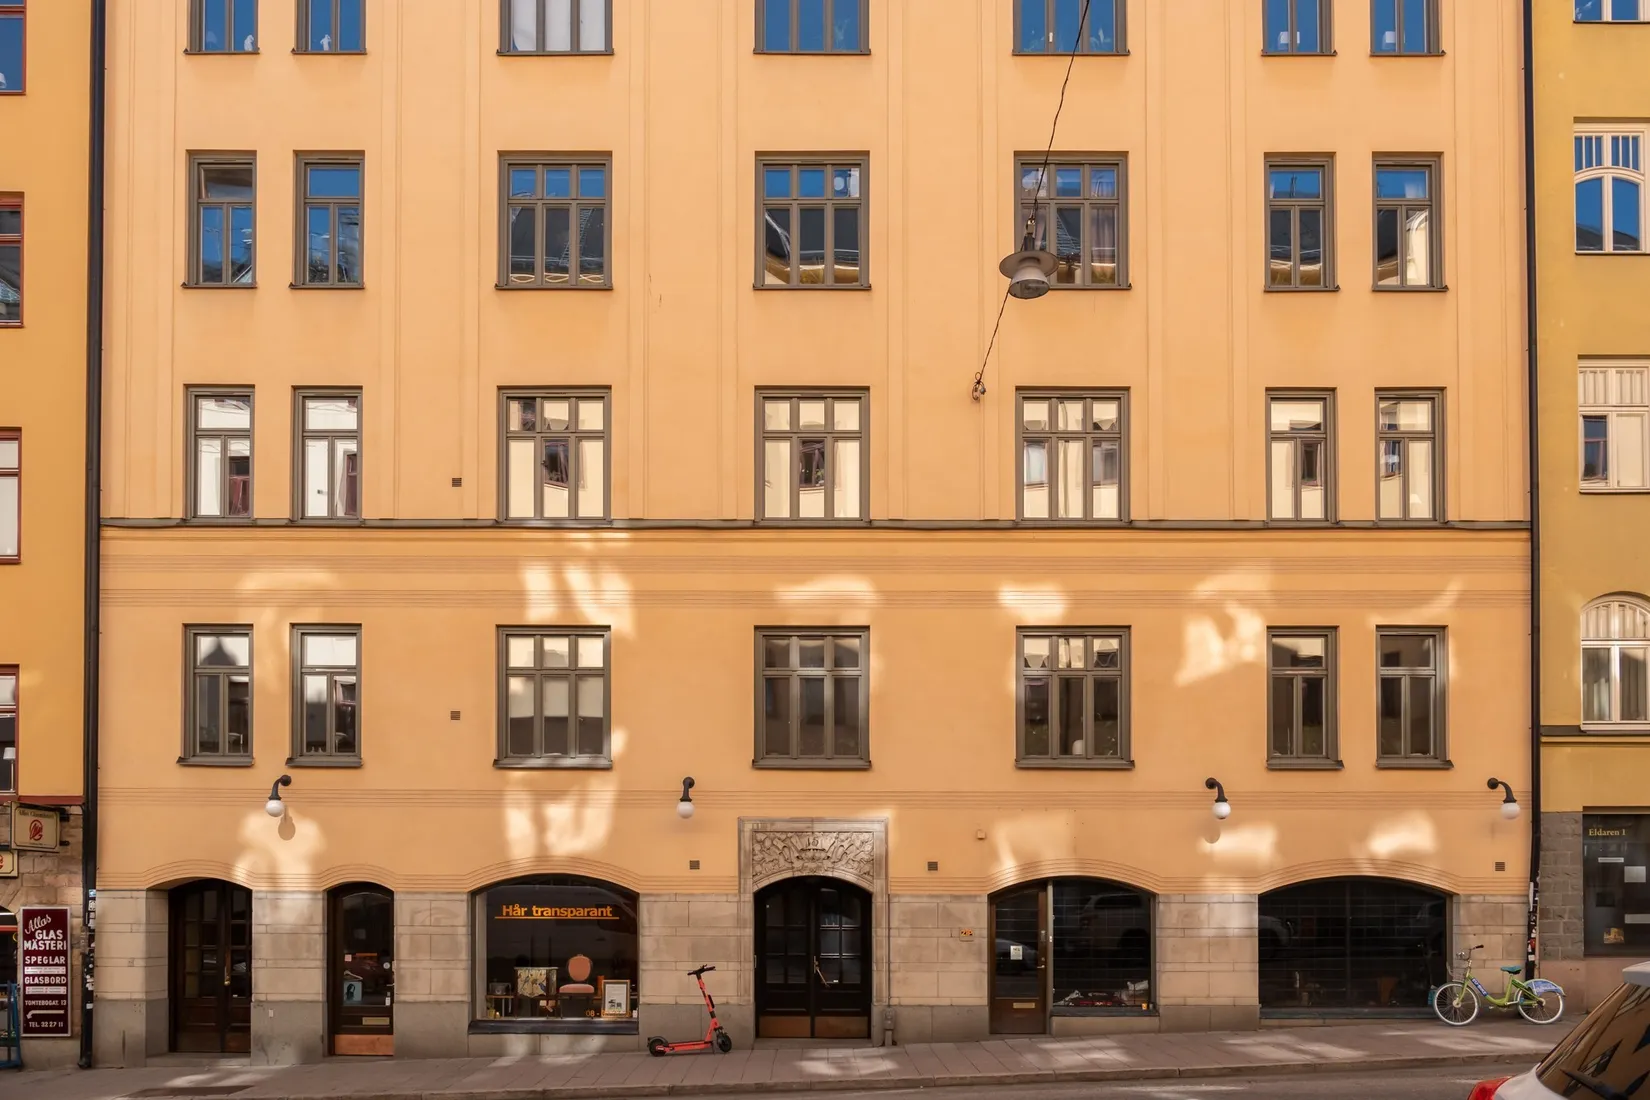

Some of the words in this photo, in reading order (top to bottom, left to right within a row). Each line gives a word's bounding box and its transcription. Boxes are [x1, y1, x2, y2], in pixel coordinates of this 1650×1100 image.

[1588, 828, 1620, 836] Eldaren
[502, 904, 527, 916] Hår
[532, 905, 613, 918] transparant
[24, 914, 52, 934] Allas
[35, 930, 63, 939] GLAS
[24, 939, 66, 950] MÄSTERI
[25, 955, 65, 964] SPEGLAR
[24, 976, 67, 985] GLASBORD
